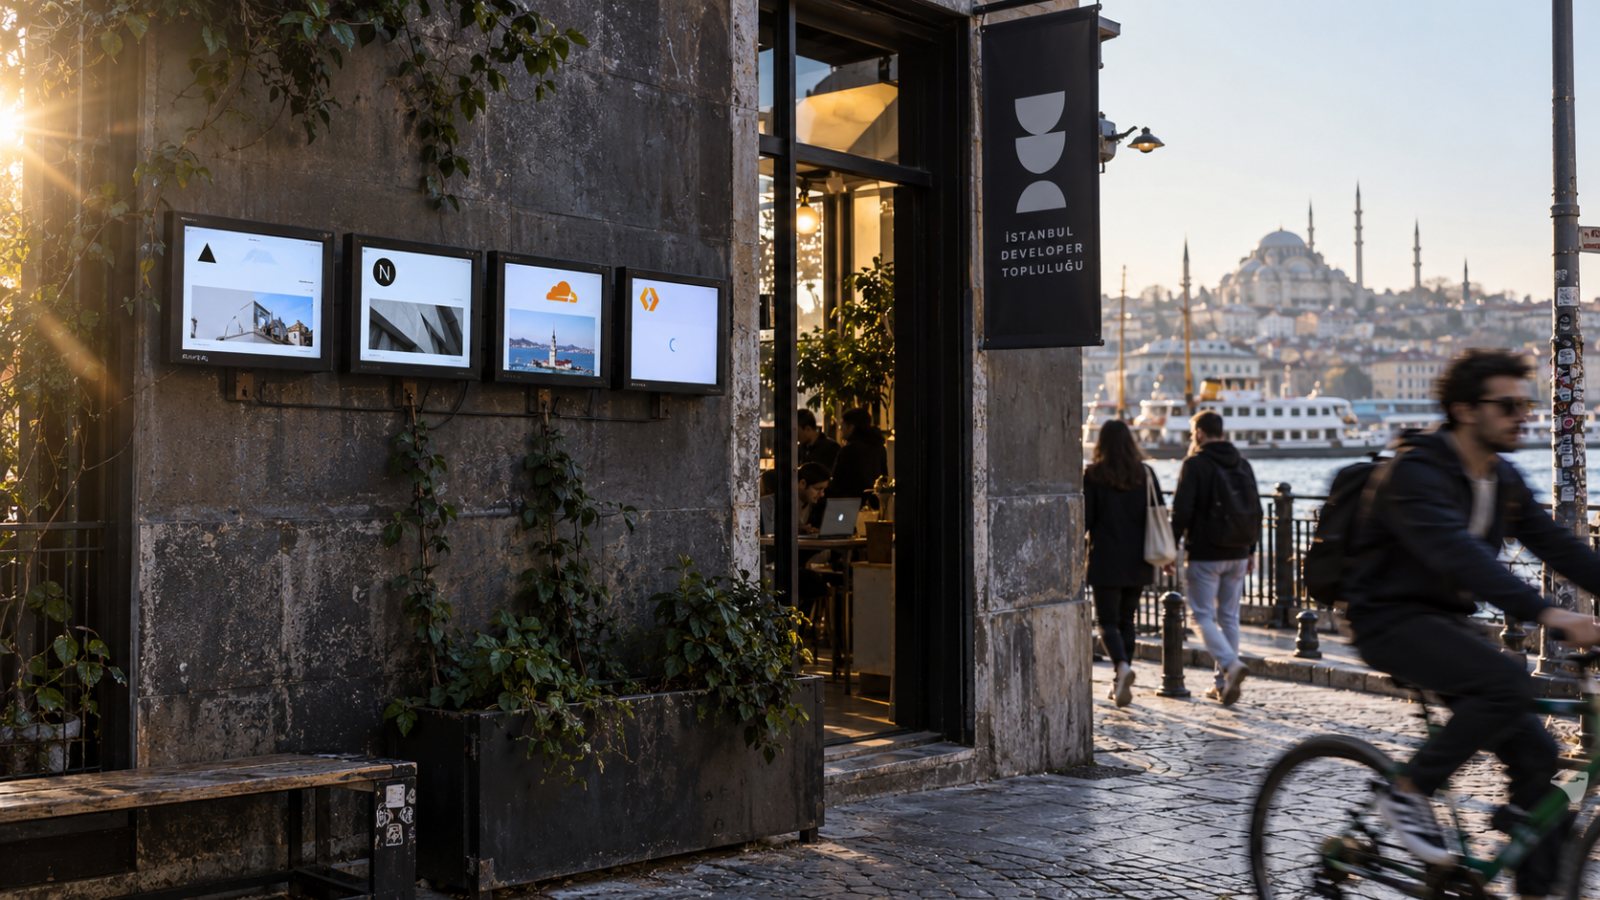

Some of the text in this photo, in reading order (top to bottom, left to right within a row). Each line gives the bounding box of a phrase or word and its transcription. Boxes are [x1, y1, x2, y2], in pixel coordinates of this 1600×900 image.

[1005, 226, 1073, 243] İSTANBUL
[1001, 243, 1083, 261] DEVELOPER
[379, 264, 390, 280] N
[1002, 260, 1083, 278] TOPLULUĞU
